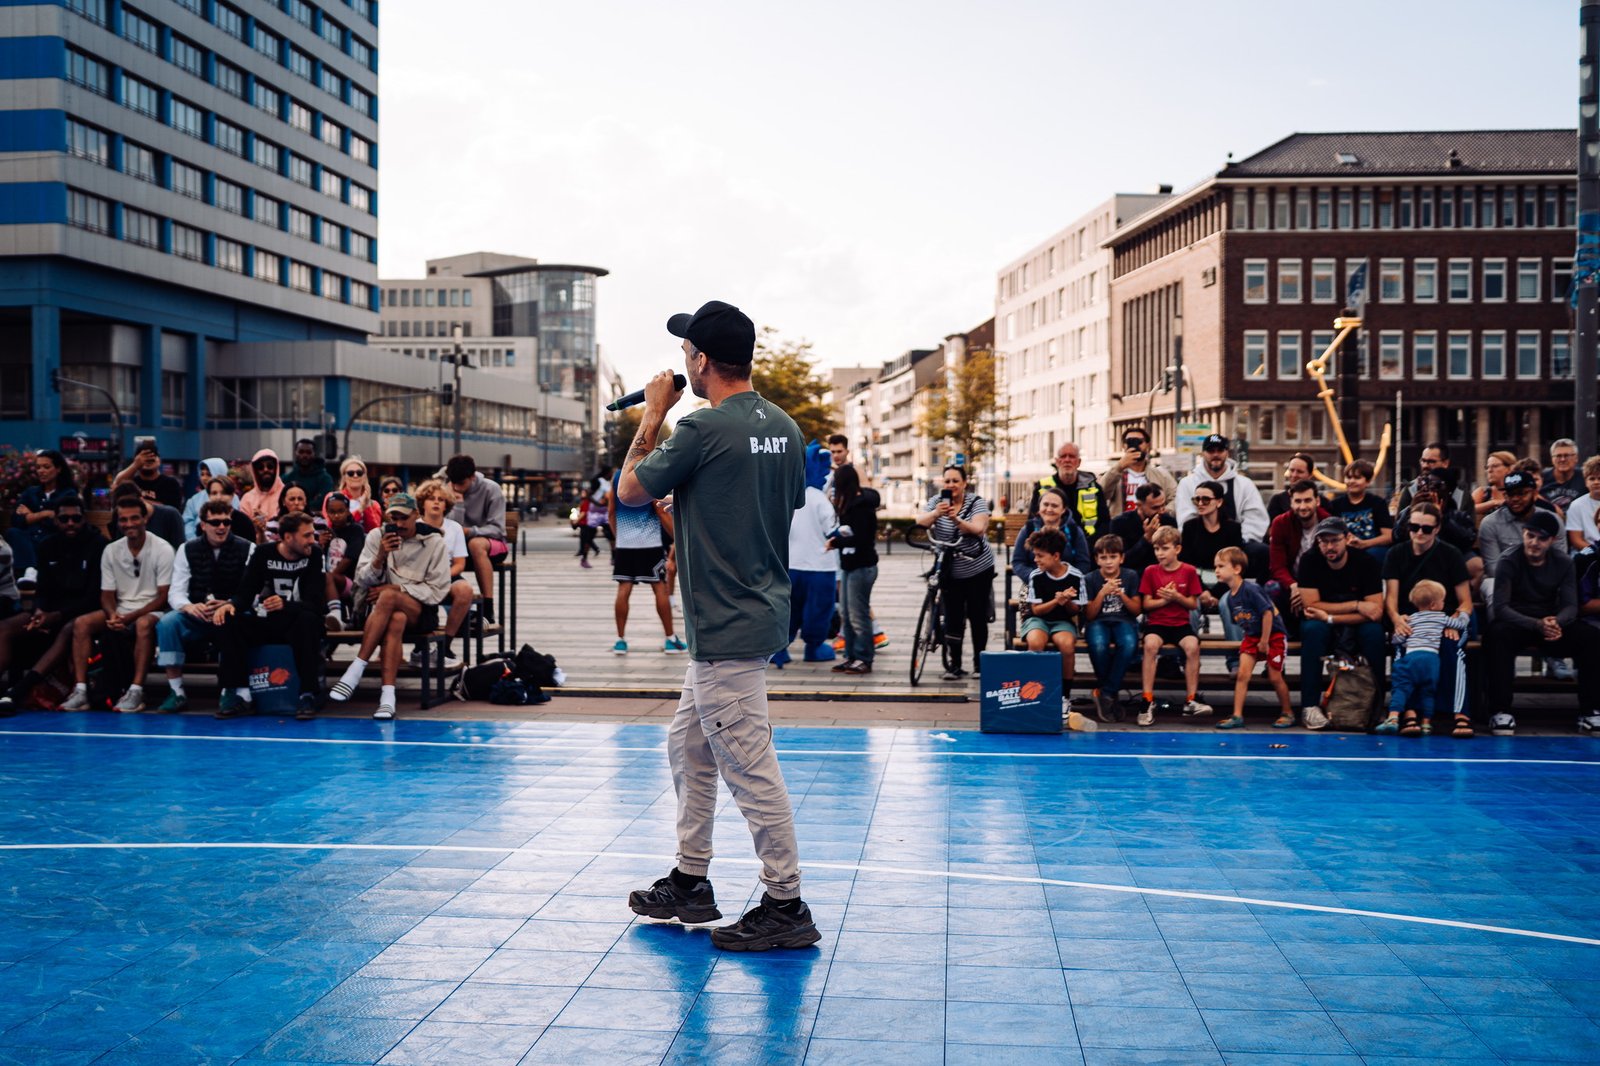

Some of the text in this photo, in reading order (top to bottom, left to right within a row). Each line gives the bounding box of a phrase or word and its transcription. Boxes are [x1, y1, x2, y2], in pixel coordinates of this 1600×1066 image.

[749, 436, 788, 454] B-ART
[267, 560, 282, 570] SAN
[986, 687, 1020, 698] BASKET
[998, 693, 1020, 702] BALL
